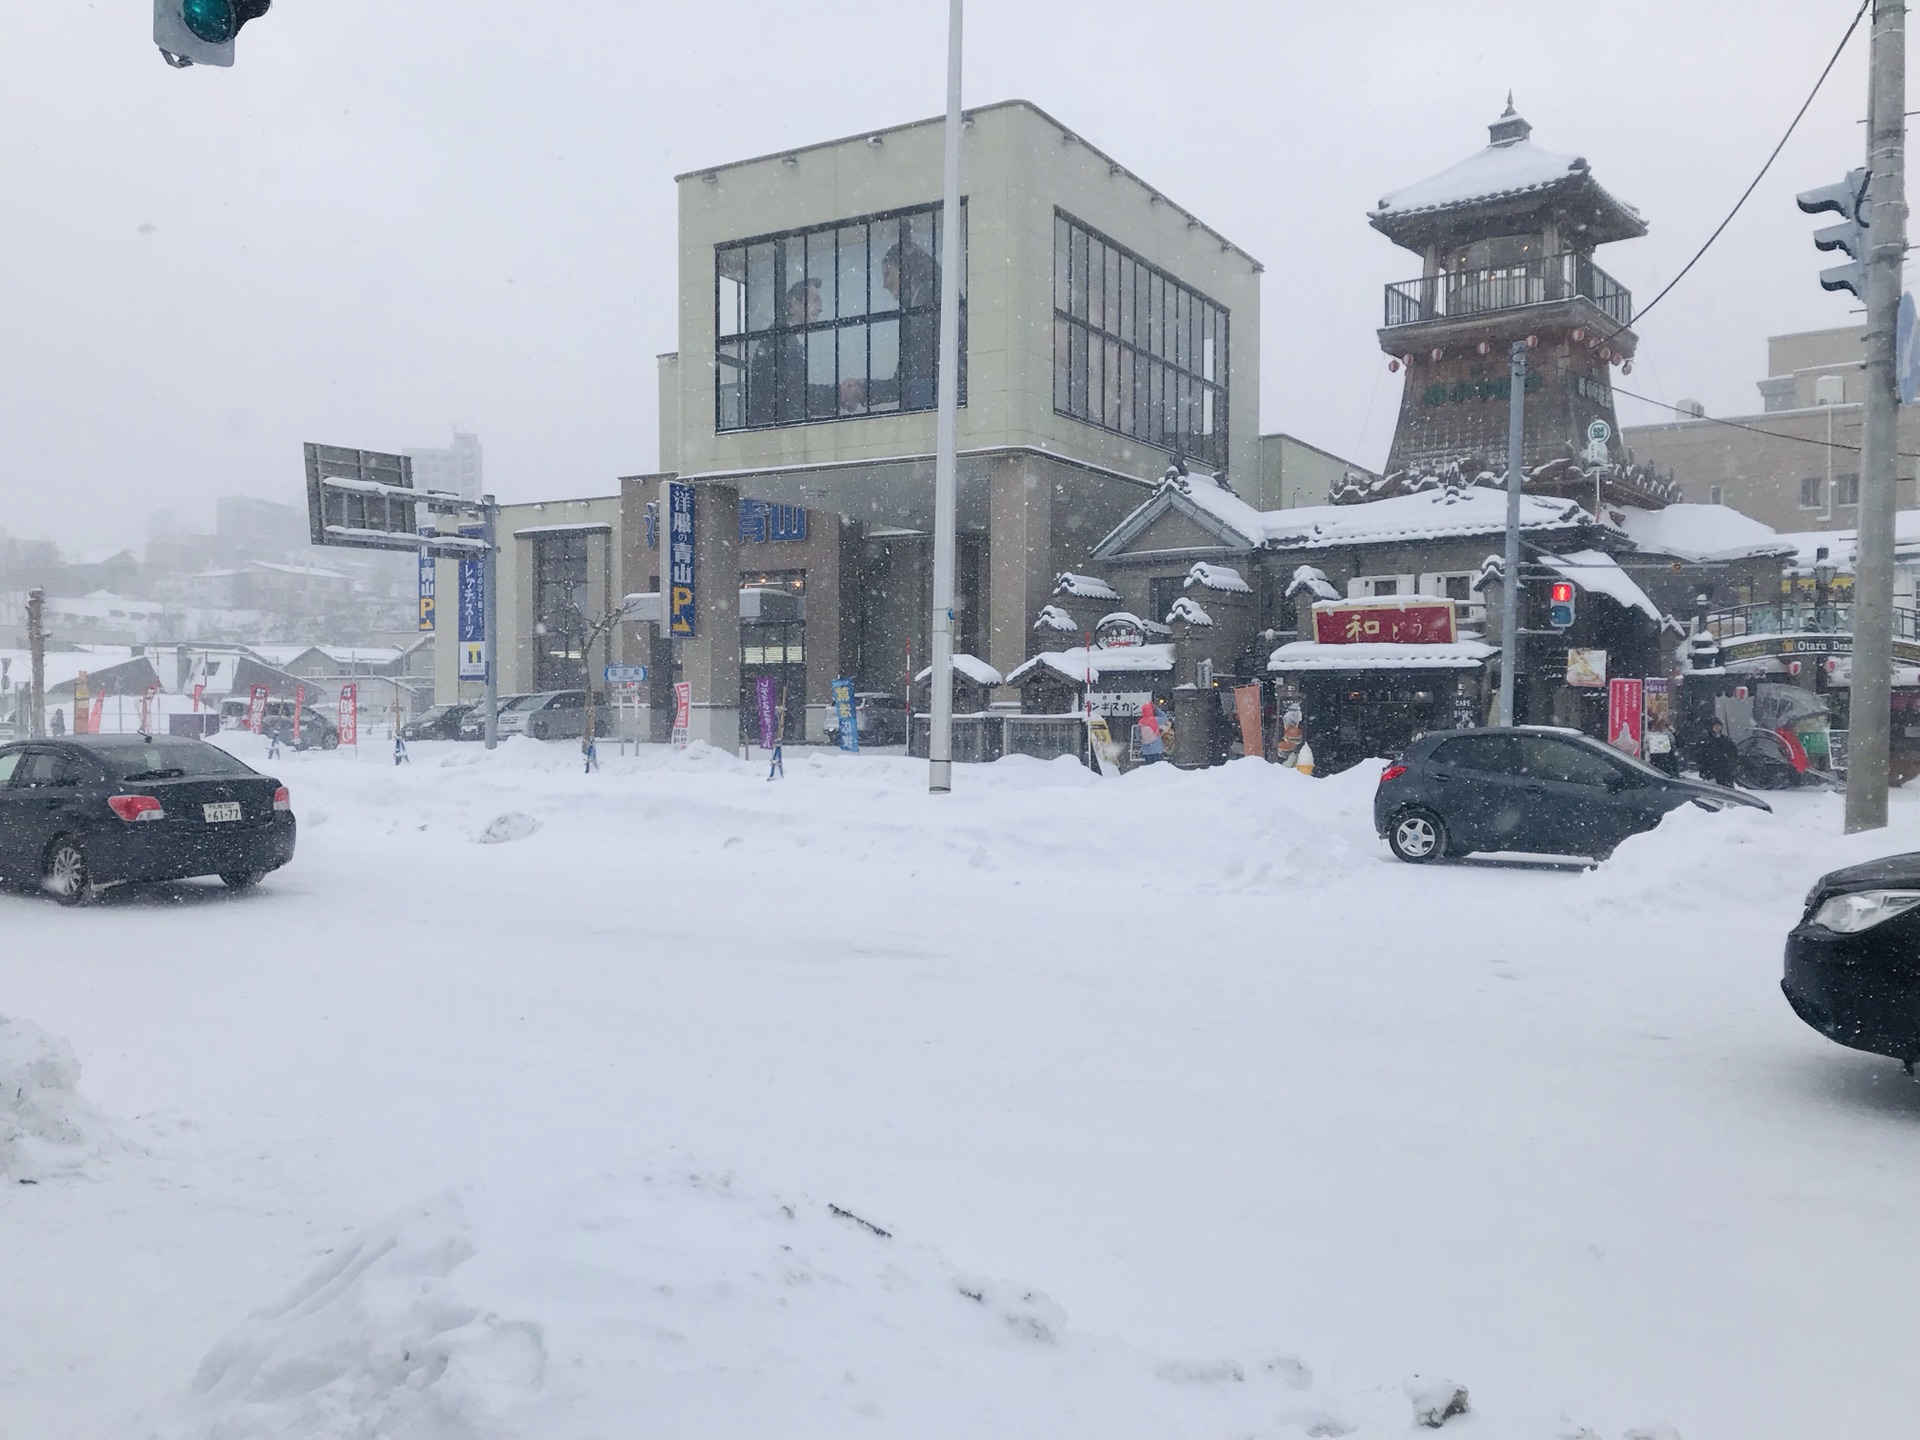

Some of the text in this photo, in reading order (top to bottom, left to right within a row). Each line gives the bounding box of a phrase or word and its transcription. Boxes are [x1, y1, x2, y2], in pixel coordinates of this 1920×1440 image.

[672, 490, 692, 583] 洋服の青山
[420, 598, 434, 618] P
[673, 587, 692, 615] P
[1346, 614, 1422, 642] 和どう
[1797, 641, 1827, 651] Otaru
[213, 809, 239, 820] 61-77
